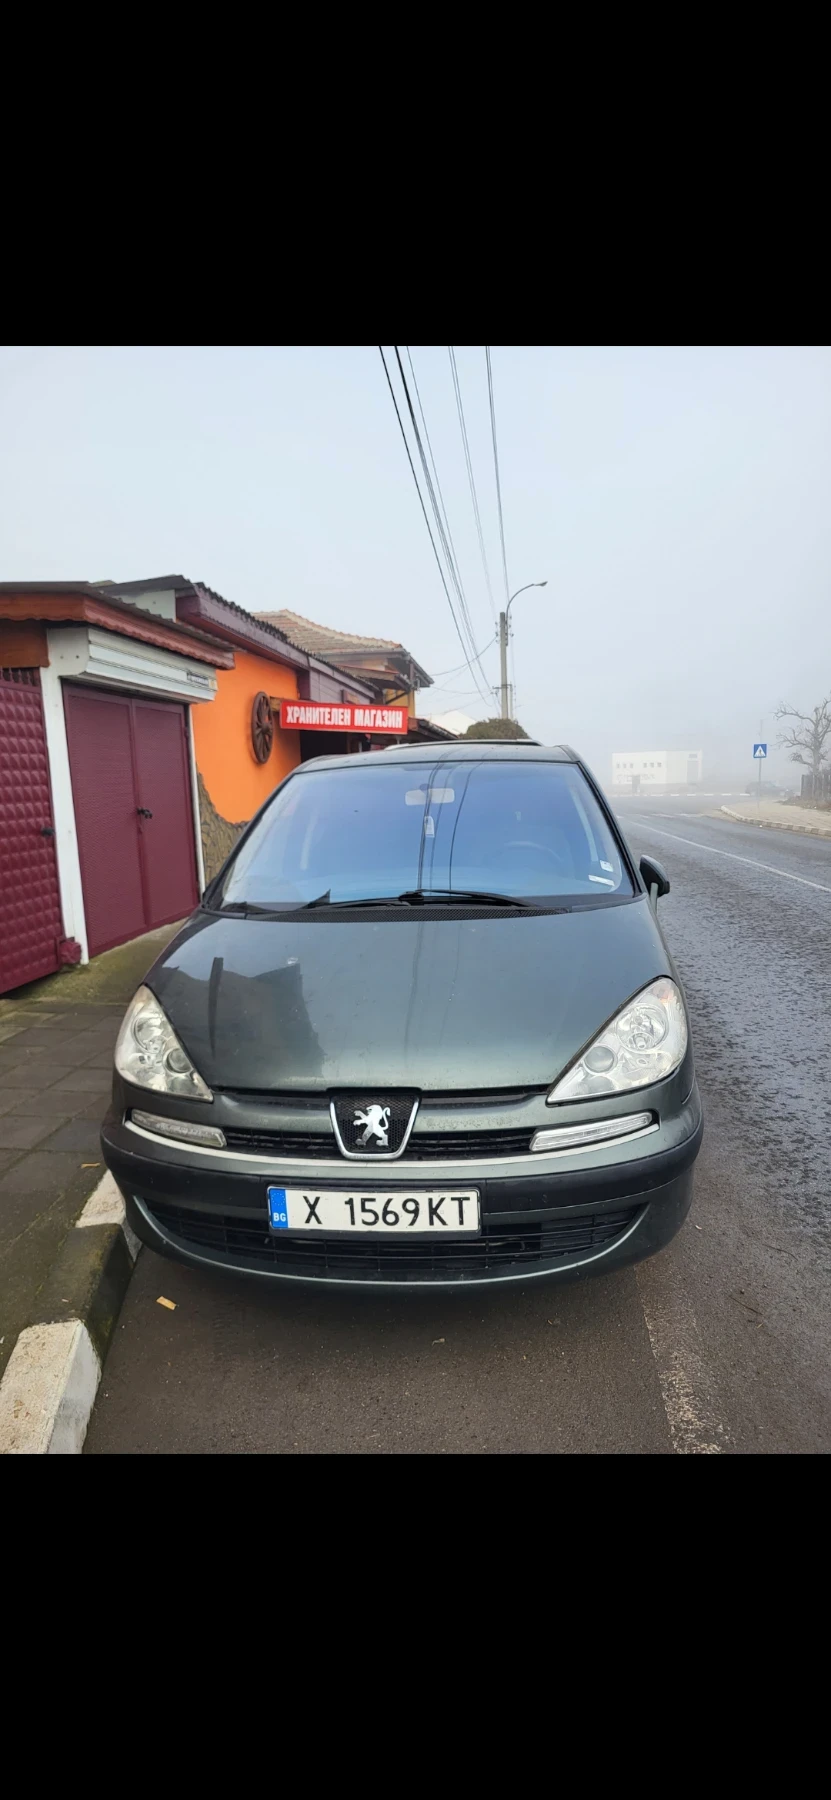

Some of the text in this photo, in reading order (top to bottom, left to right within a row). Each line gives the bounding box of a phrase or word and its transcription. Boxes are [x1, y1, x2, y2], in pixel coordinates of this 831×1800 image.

[286, 706, 403, 729] ХРАНИТЕЛЕН МАГАЗИН
[273, 1212, 287, 1222] BG
